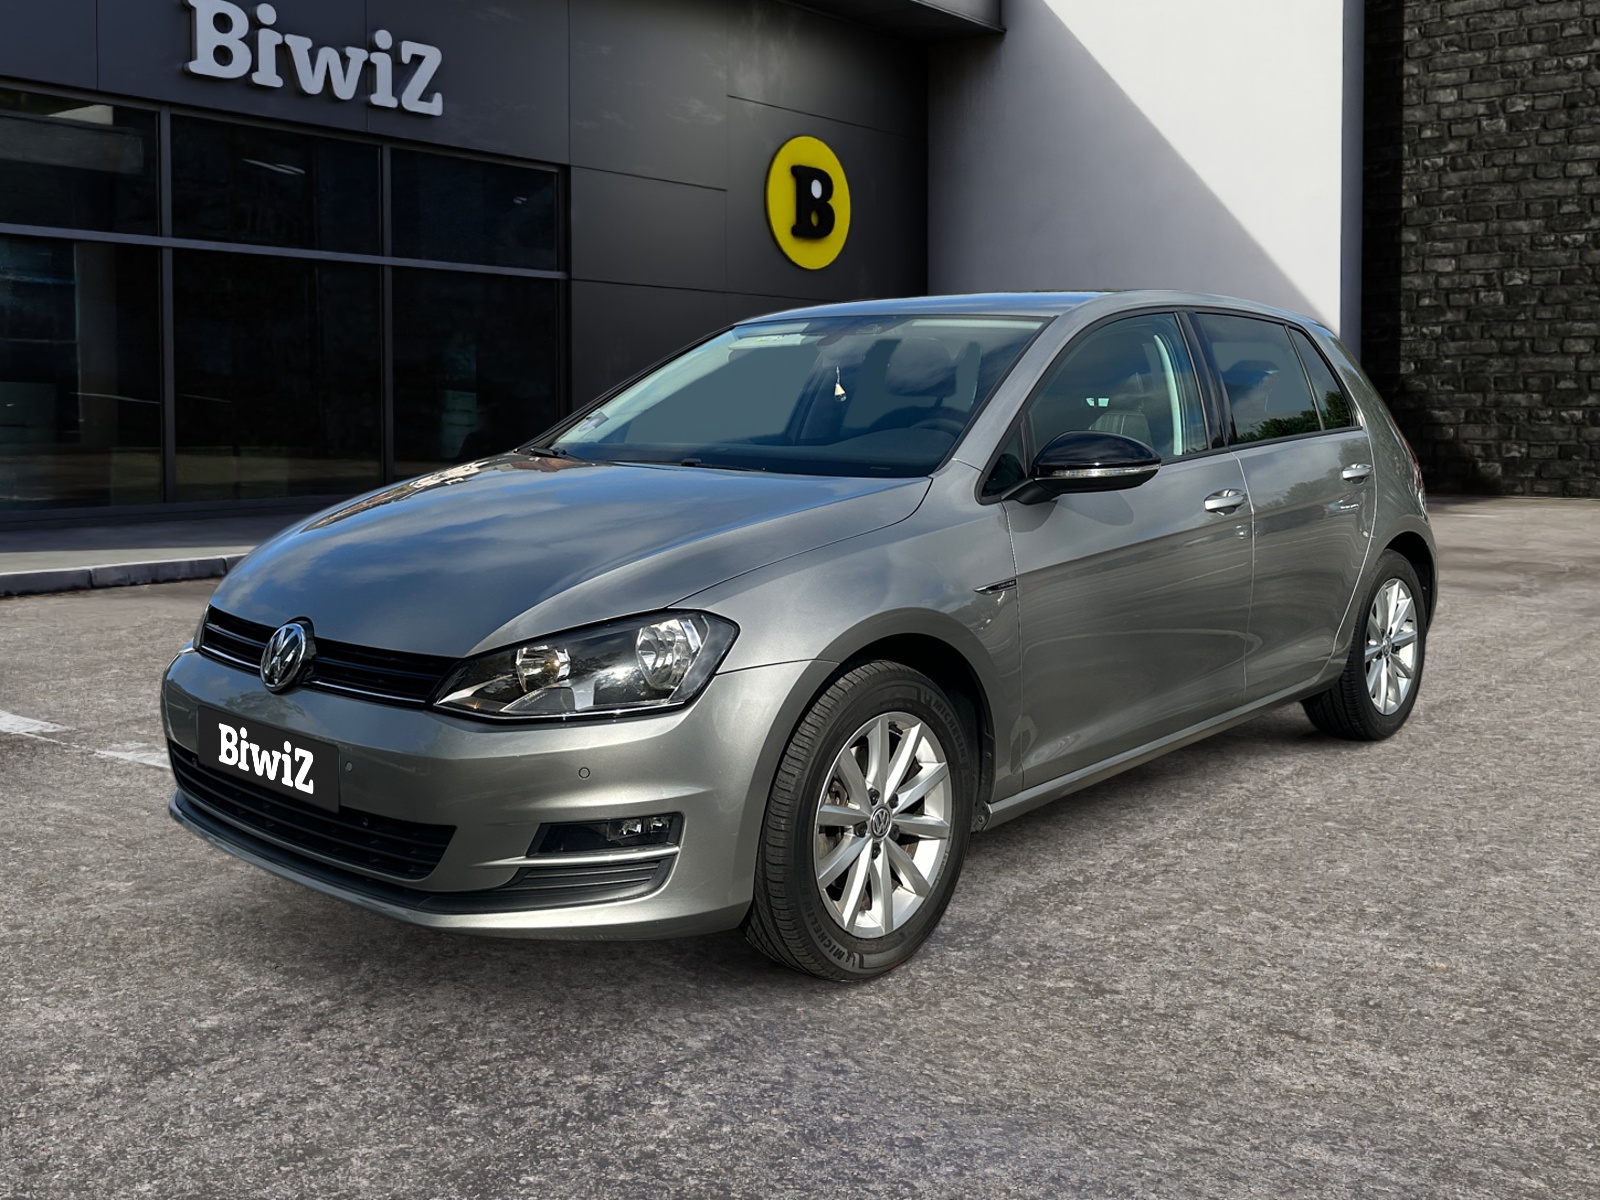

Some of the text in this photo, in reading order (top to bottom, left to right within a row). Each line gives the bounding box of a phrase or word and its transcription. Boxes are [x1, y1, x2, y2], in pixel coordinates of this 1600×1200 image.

[186, 0, 444, 117] BiwiZ
[790, 164, 835, 239] B
[218, 722, 314, 795] BiwiZ
